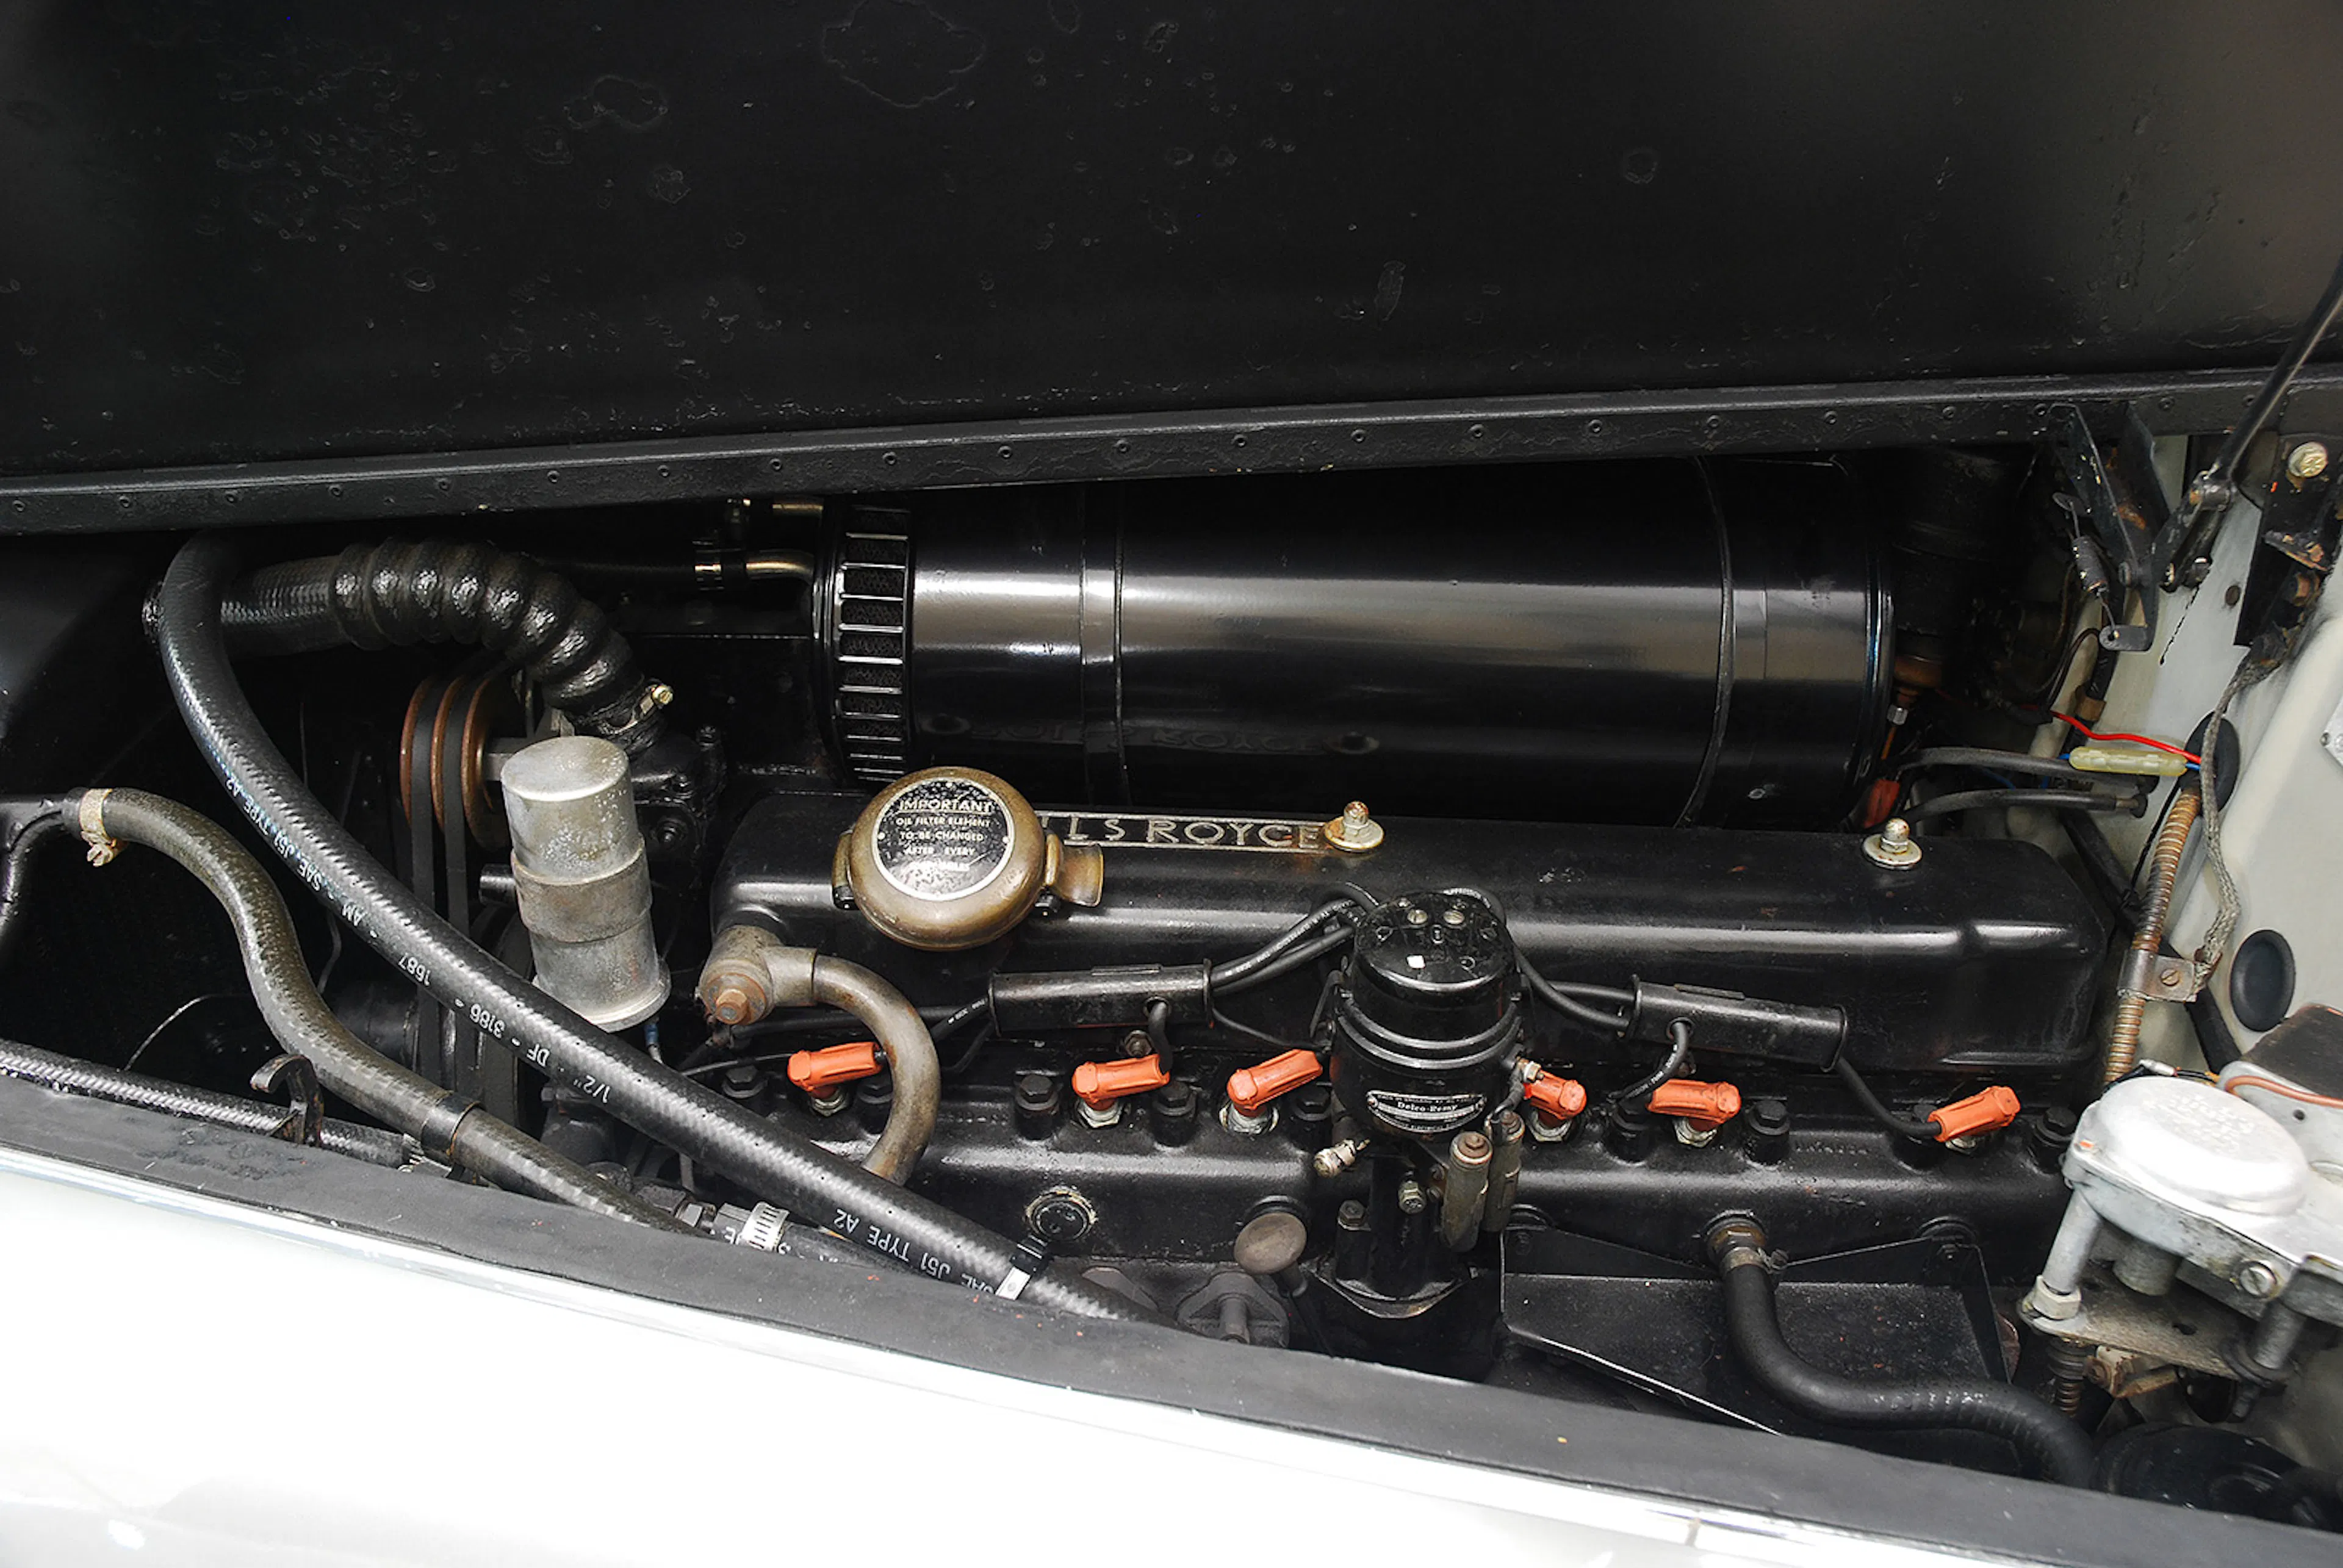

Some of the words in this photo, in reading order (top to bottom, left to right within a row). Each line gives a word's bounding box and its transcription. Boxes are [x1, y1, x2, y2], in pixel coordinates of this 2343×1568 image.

[244, 794, 272, 835] TYPE
[899, 799, 992, 812] IMPORTANT
[895, 818, 913, 826] OIL
[915, 818, 945, 826] FILTER
[948, 818, 990, 827] ELEMENT
[1146, 819, 1322, 849] ROYCE
[935, 831, 984, 841] CHANGED
[904, 846, 934, 855] AFTER
[297, 857, 322, 891] SAE
[342, 903, 367, 926] AM
[398, 952, 431, 986] 1687
[470, 1004, 505, 1038] 3186
[527, 1043, 550, 1067] DF
[574, 1074, 610, 1103] 1/2"
[833, 1207, 860, 1233] A2
[866, 1225, 910, 1262] TYPE
[920, 1253, 951, 1279] J51
